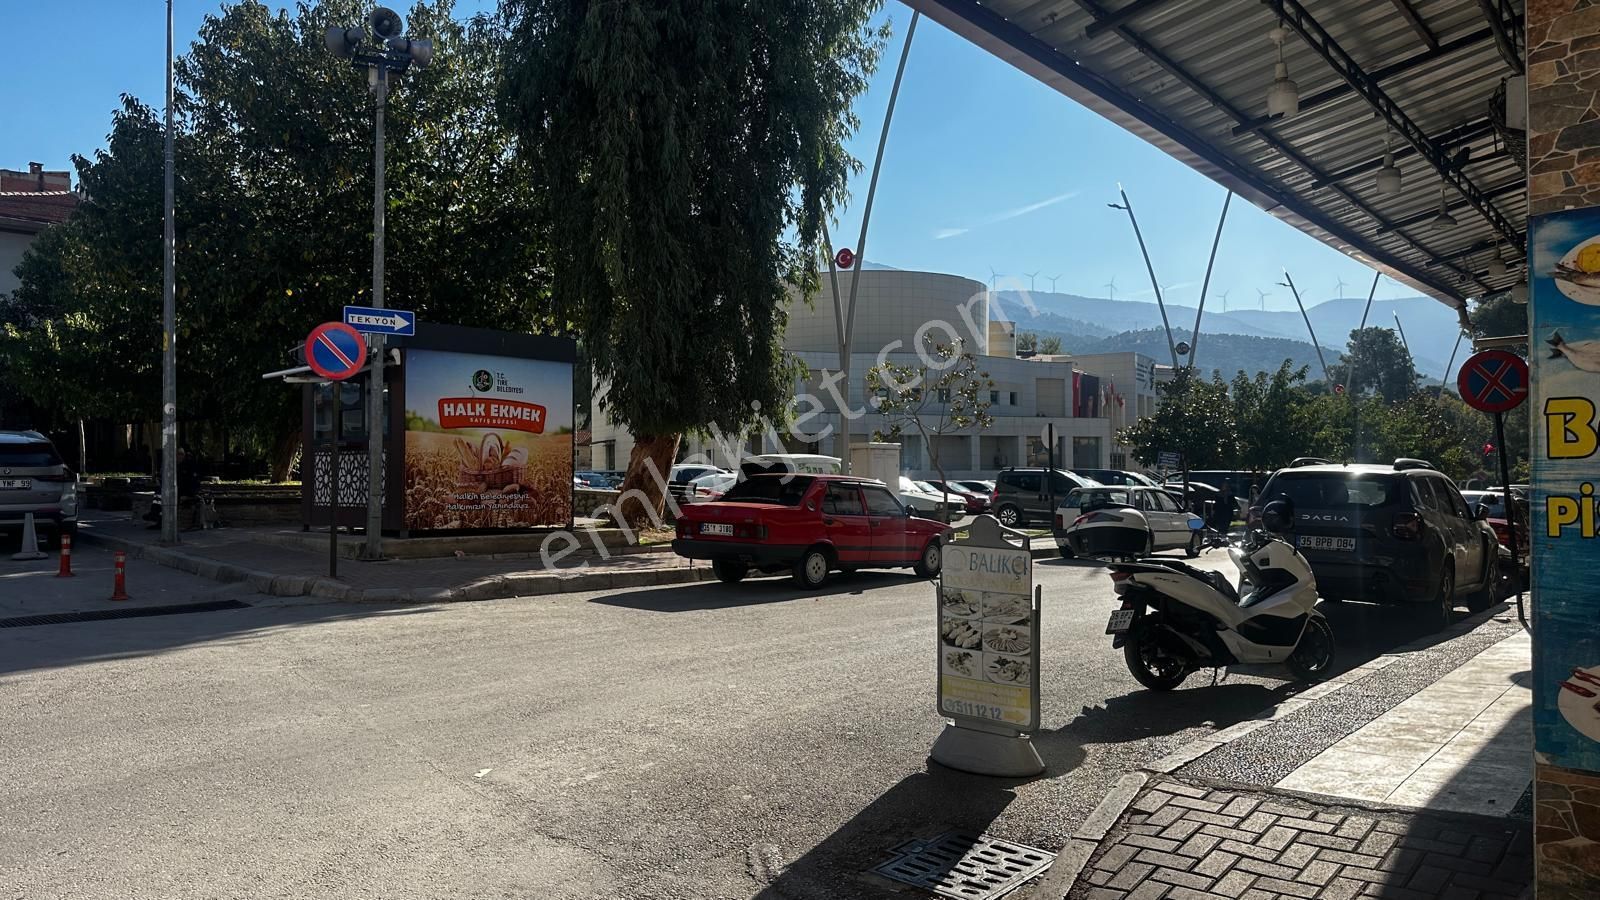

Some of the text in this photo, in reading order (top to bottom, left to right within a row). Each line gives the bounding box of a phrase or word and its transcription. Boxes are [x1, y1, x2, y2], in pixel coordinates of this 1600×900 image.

[350, 315, 371, 324] TEK
[443, 402, 541, 422] HALK EKMEK
[1543, 396, 1600, 459] B
[1301, 514, 1349, 522] DACIA
[1300, 536, 1312, 546] 35
[1336, 538, 1354, 549] 084
[969, 552, 1027, 581] BALIKÇI
[975, 704, 987, 718] 12
[990, 707, 1002, 720] 12
